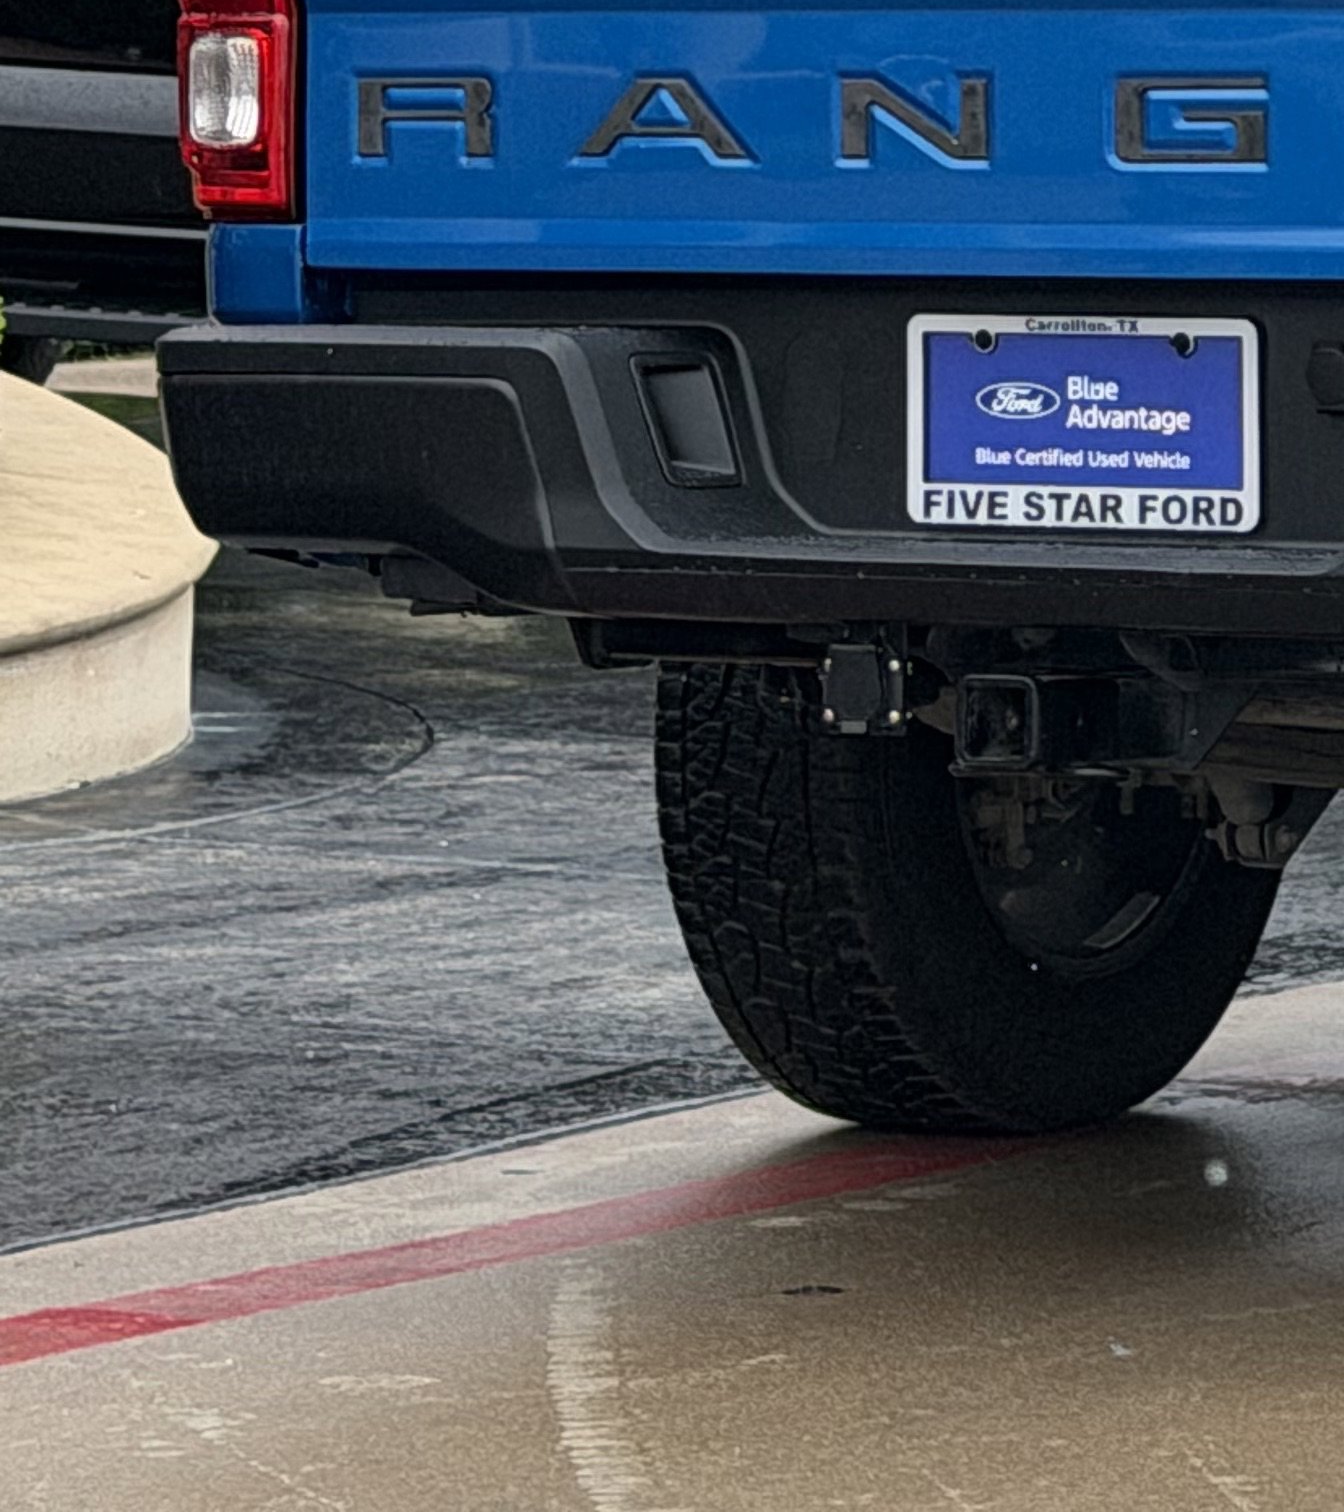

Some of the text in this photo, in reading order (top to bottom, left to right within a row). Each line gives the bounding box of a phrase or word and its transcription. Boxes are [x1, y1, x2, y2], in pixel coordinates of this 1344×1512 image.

[1116, 319, 1139, 333] TX
[991, 386, 1044, 414] Ford
[1066, 376, 1119, 401] Blue
[1065, 404, 1191, 435] Advantage
[975, 447, 1191, 470] Blue Certified Used Vehicle
[923, 490, 1244, 527] FIVE STAR FORD
